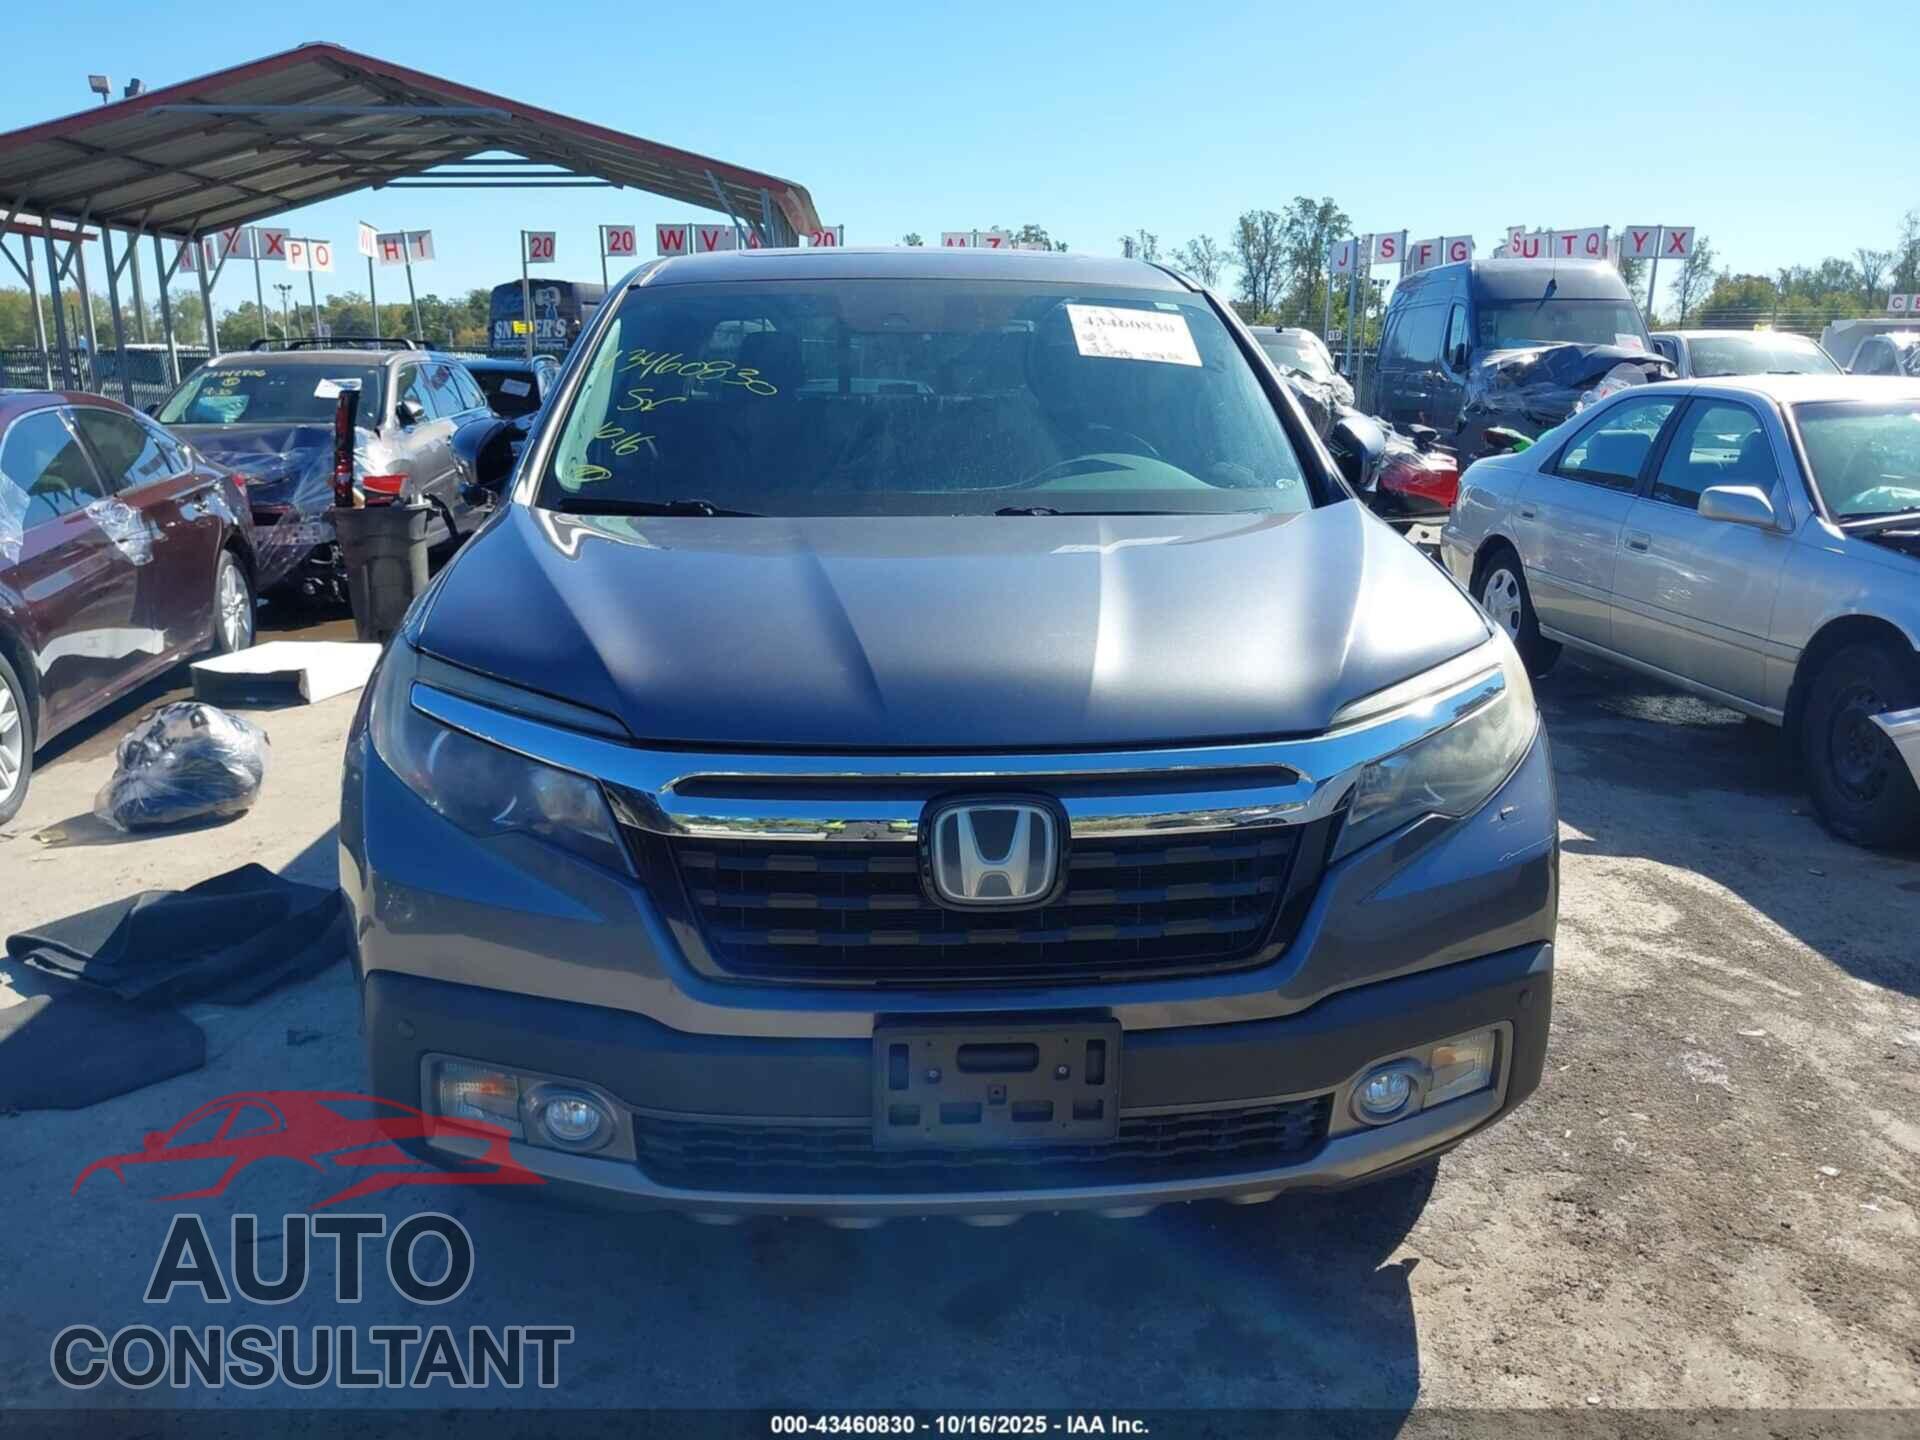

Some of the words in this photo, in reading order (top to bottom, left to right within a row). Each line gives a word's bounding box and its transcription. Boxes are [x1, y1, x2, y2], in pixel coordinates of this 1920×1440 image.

[265, 233, 284, 256] X
[382, 238, 400, 261] H
[530, 236, 554, 259] 20
[609, 230, 634, 252] 20
[659, 229, 684, 251] W
[701, 229, 719, 252] V
[1381, 238, 1395, 258] S
[1512, 232, 1521, 252] S
[1523, 239, 1539, 258] U
[1562, 235, 1578, 255] T
[1586, 233, 1599, 255] Q
[1632, 231, 1649, 253] Y
[1669, 232, 1686, 254] X
[290, 243, 301, 264] P
[1338, 246, 1349, 267] J
[1420, 244, 1432, 266] F
[1450, 241, 1467, 262] G
[1892, 296, 1903, 310] C
